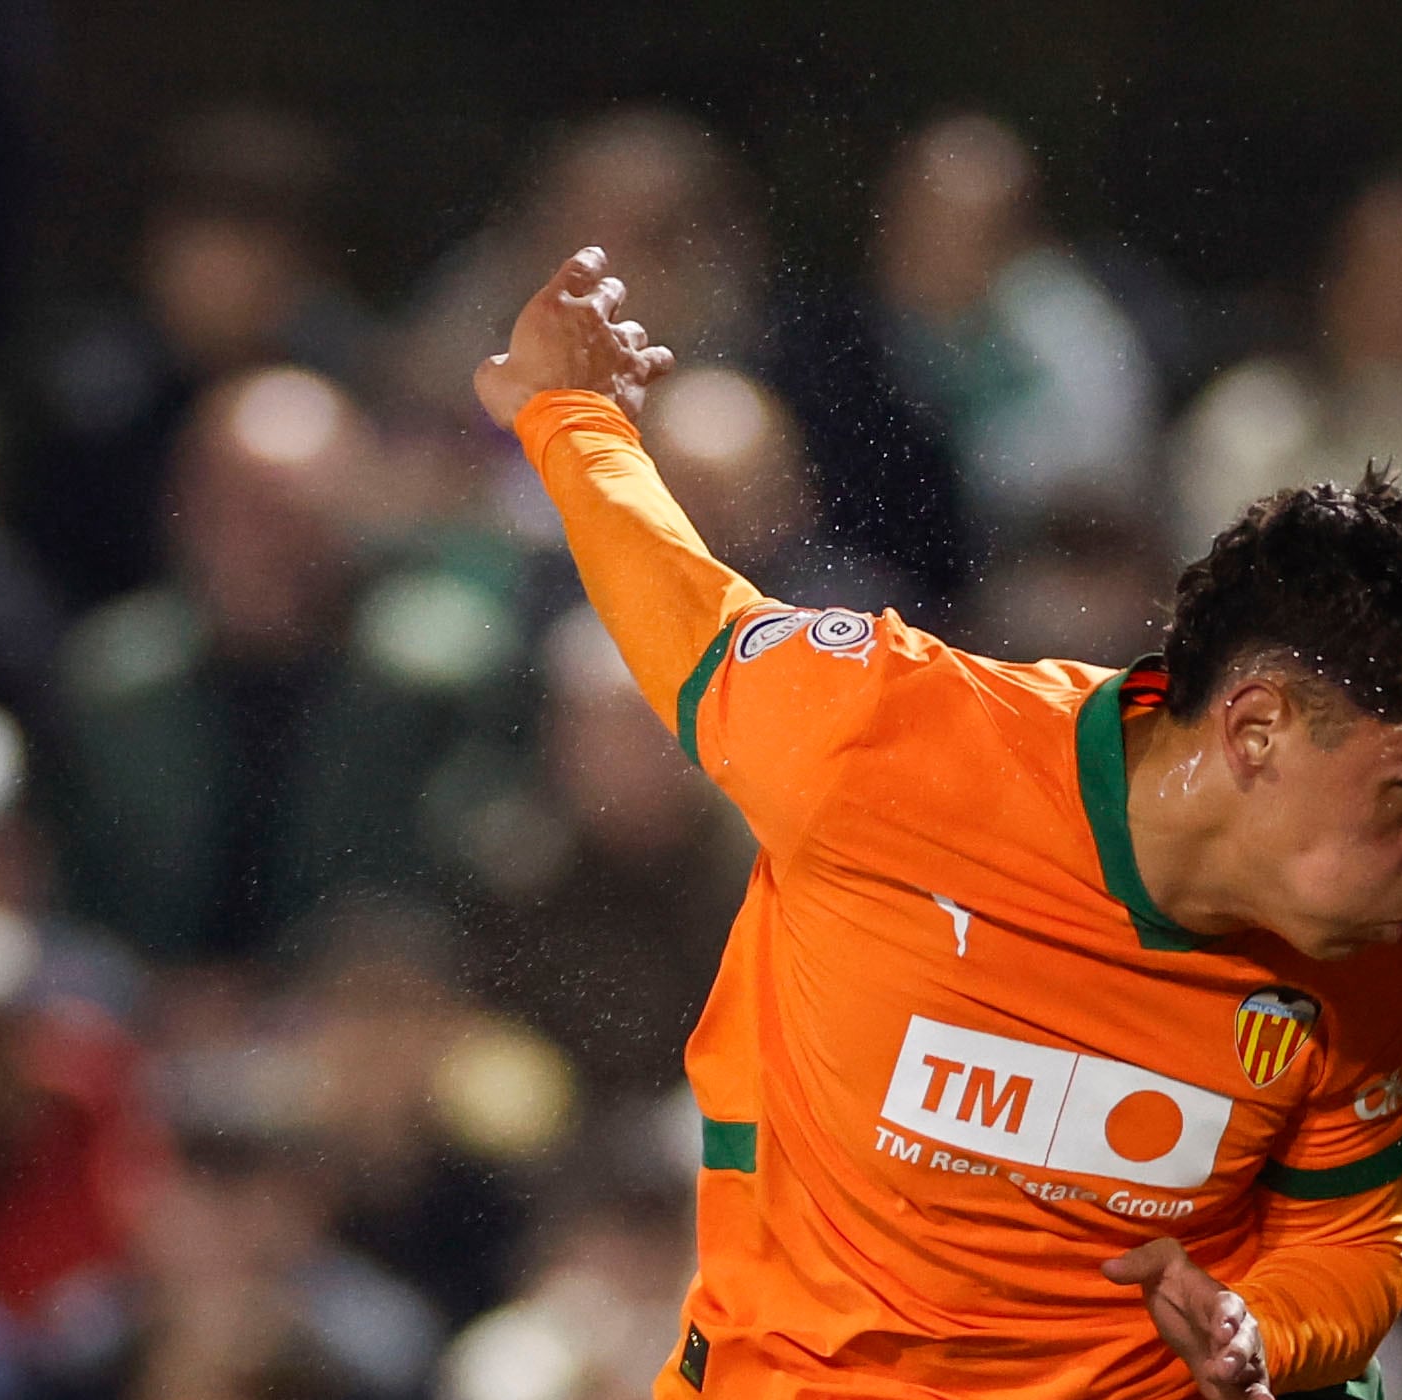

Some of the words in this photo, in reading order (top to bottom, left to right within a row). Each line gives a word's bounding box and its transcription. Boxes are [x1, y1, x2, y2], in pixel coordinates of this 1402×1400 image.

[921, 1053, 1034, 1135] TM
[874, 1126, 922, 1164] TM
[1106, 1190, 1194, 1220] Group
